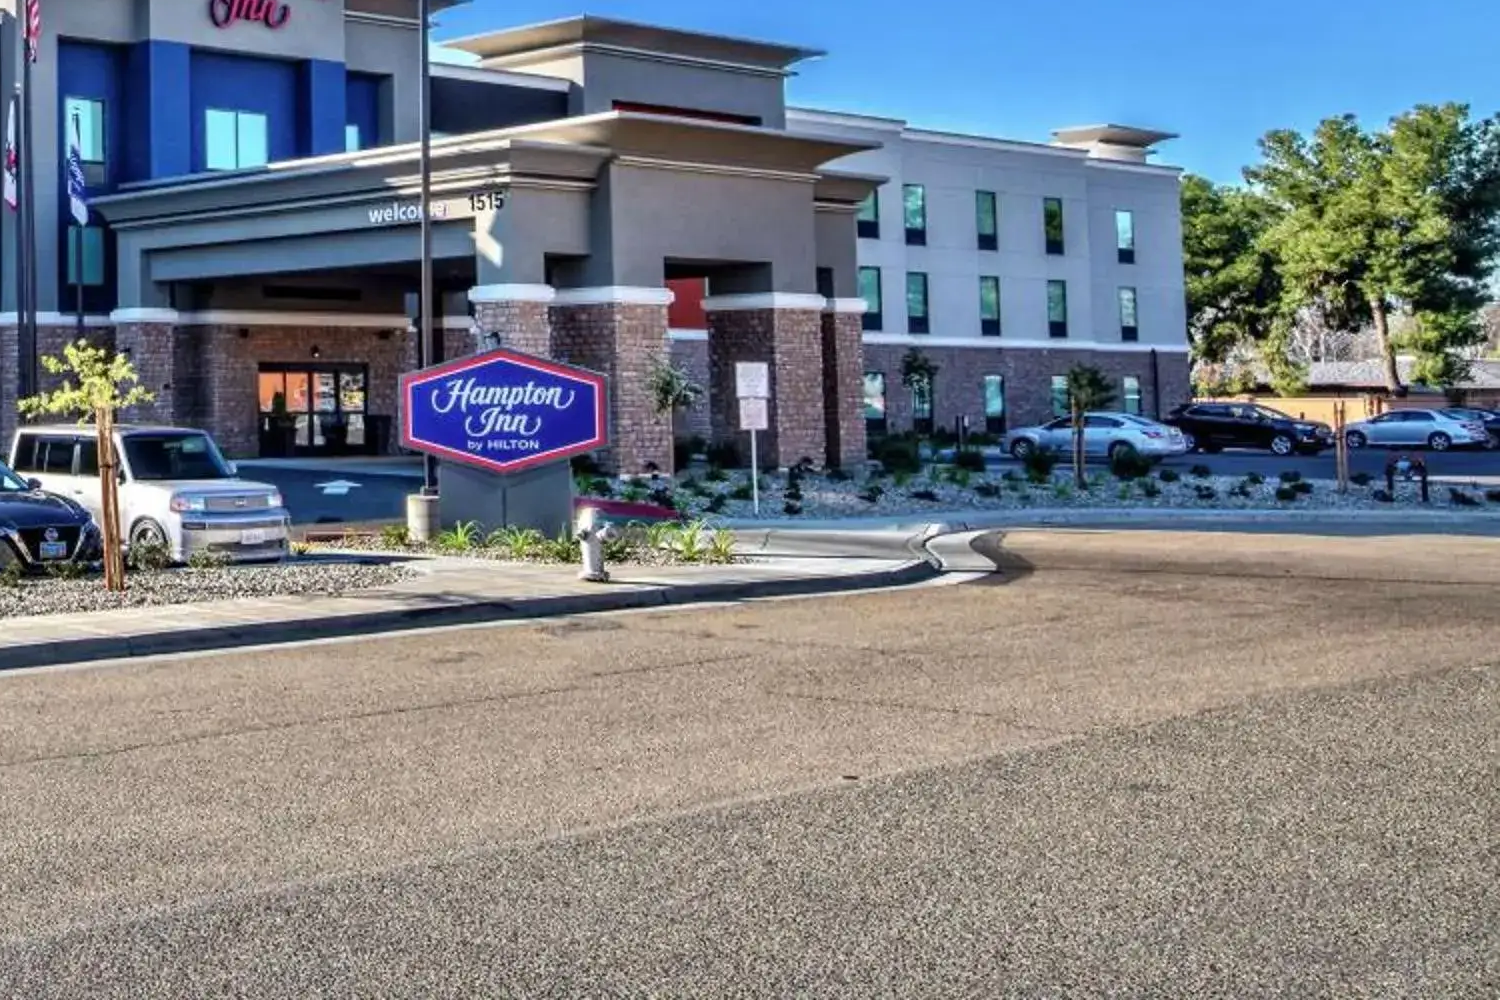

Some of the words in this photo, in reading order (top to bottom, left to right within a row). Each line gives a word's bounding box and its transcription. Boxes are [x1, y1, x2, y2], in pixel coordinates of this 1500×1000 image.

[468, 191, 504, 211] 1515
[431, 377, 575, 413] Hampton
[465, 406, 541, 437] Inn
[467, 440, 483, 450] by
[487, 439, 539, 450] HILTON
